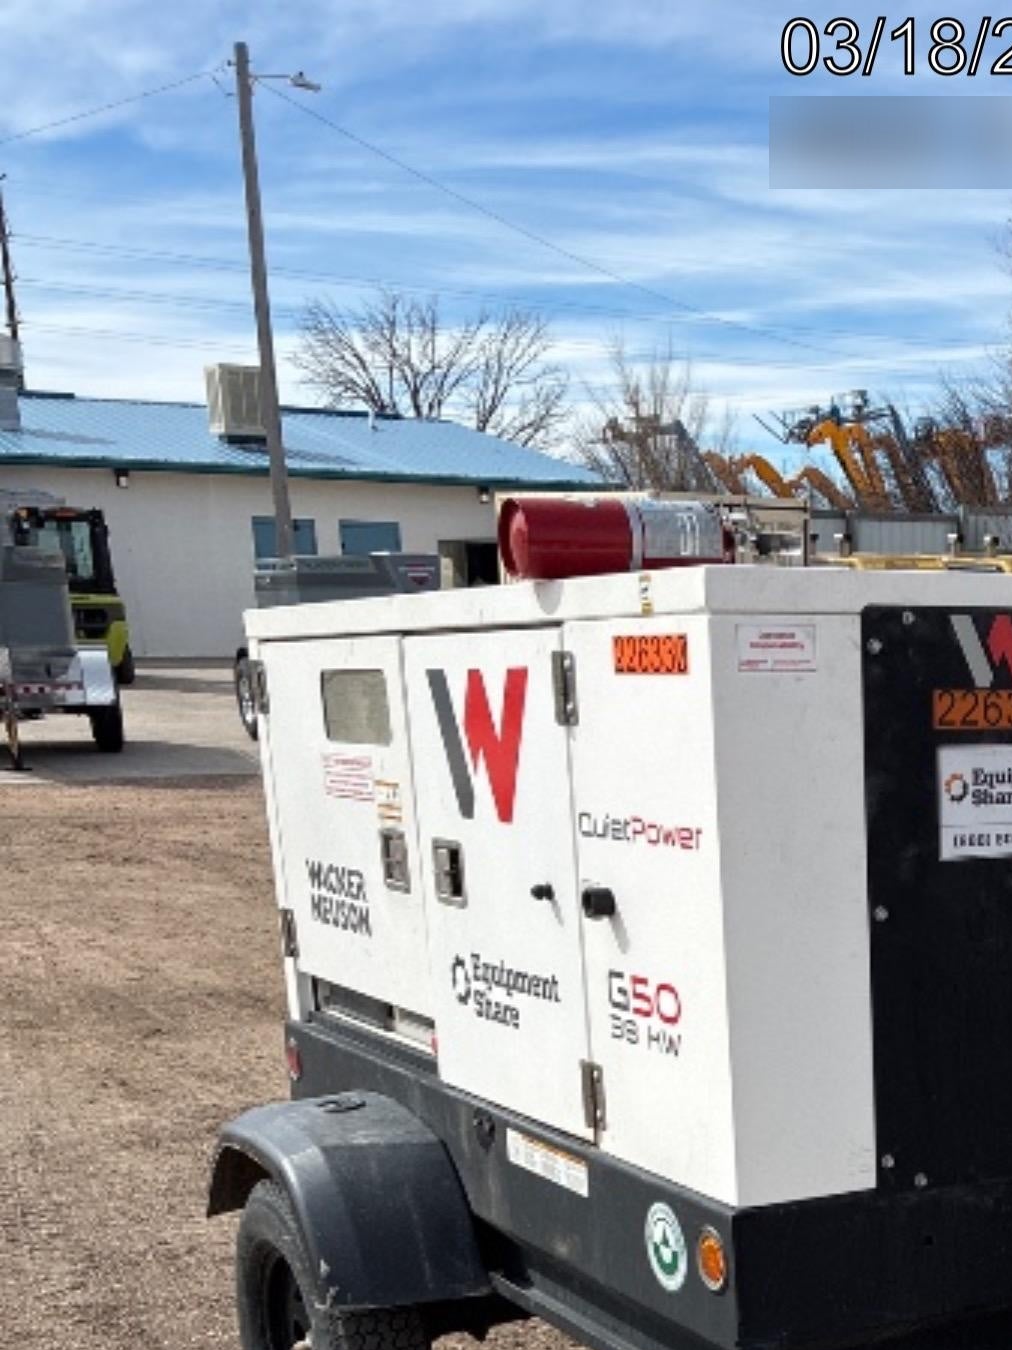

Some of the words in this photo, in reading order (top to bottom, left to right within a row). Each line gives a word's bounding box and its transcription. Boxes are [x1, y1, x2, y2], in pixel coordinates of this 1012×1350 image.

[578, 812, 703, 850] QuietPower
[470, 952, 562, 1003] Equipment
[608, 969, 682, 1026] G50
[473, 988, 520, 1029] Share
